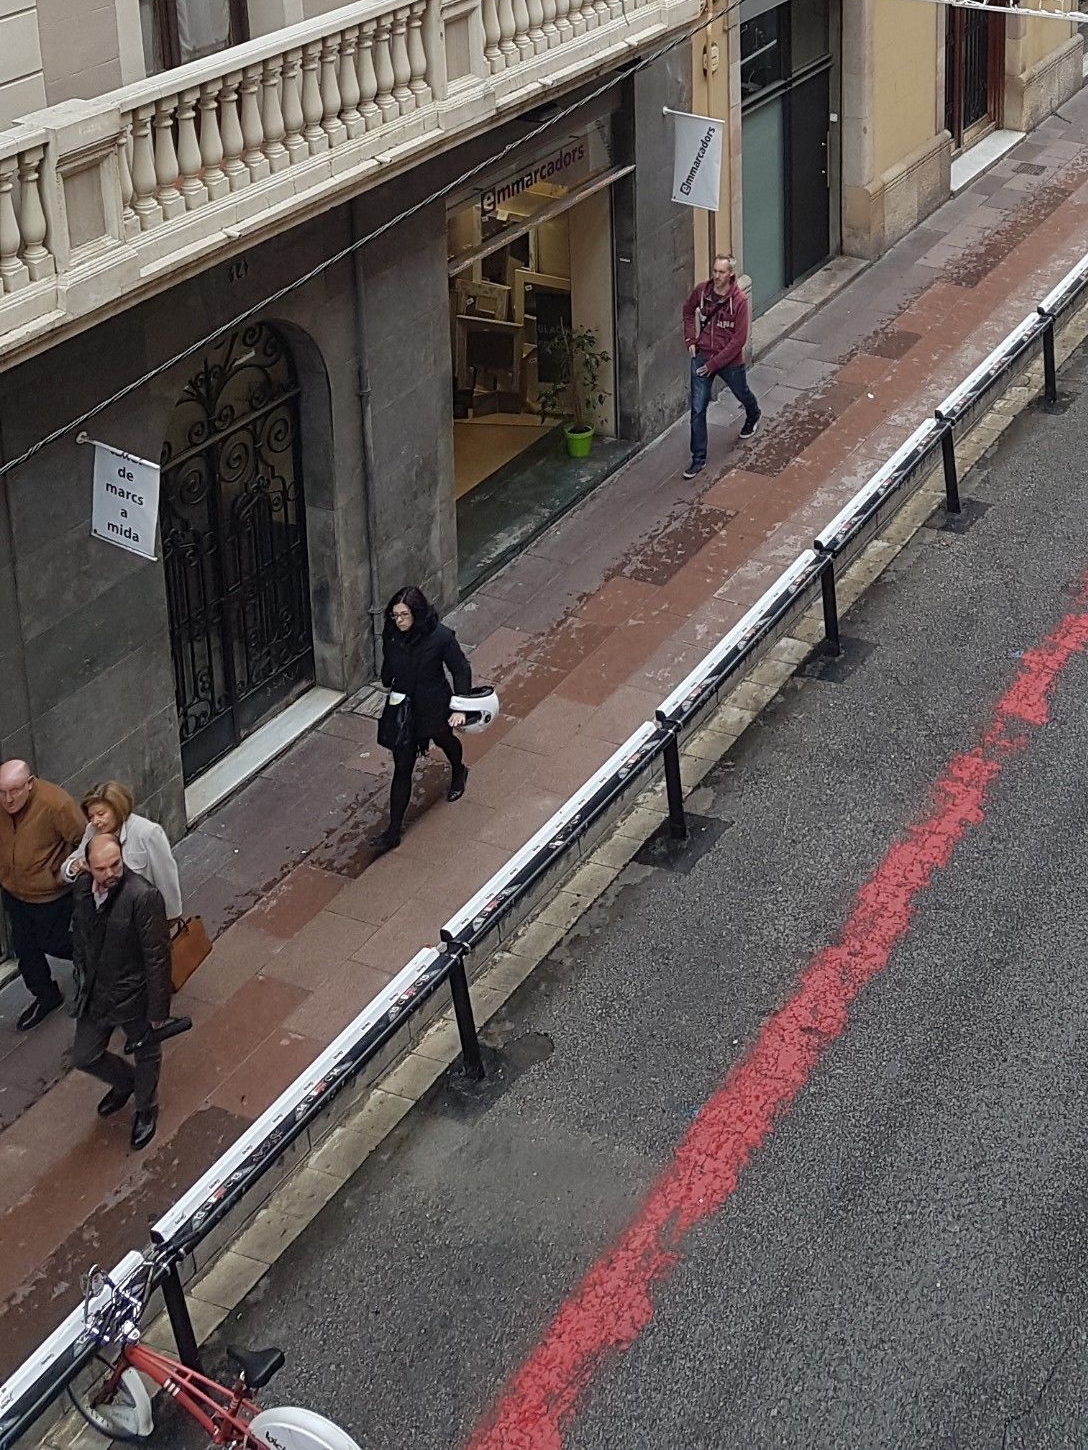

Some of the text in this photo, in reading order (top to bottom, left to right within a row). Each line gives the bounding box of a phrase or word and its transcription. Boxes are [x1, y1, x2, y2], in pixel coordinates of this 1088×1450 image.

[679, 126, 716, 197] emmarcadors
[481, 143, 584, 215] emmarcadors
[117, 466, 134, 482] de
[105, 481, 144, 506] marcs
[120, 508, 128, 519] a
[107, 521, 140, 543] mida
